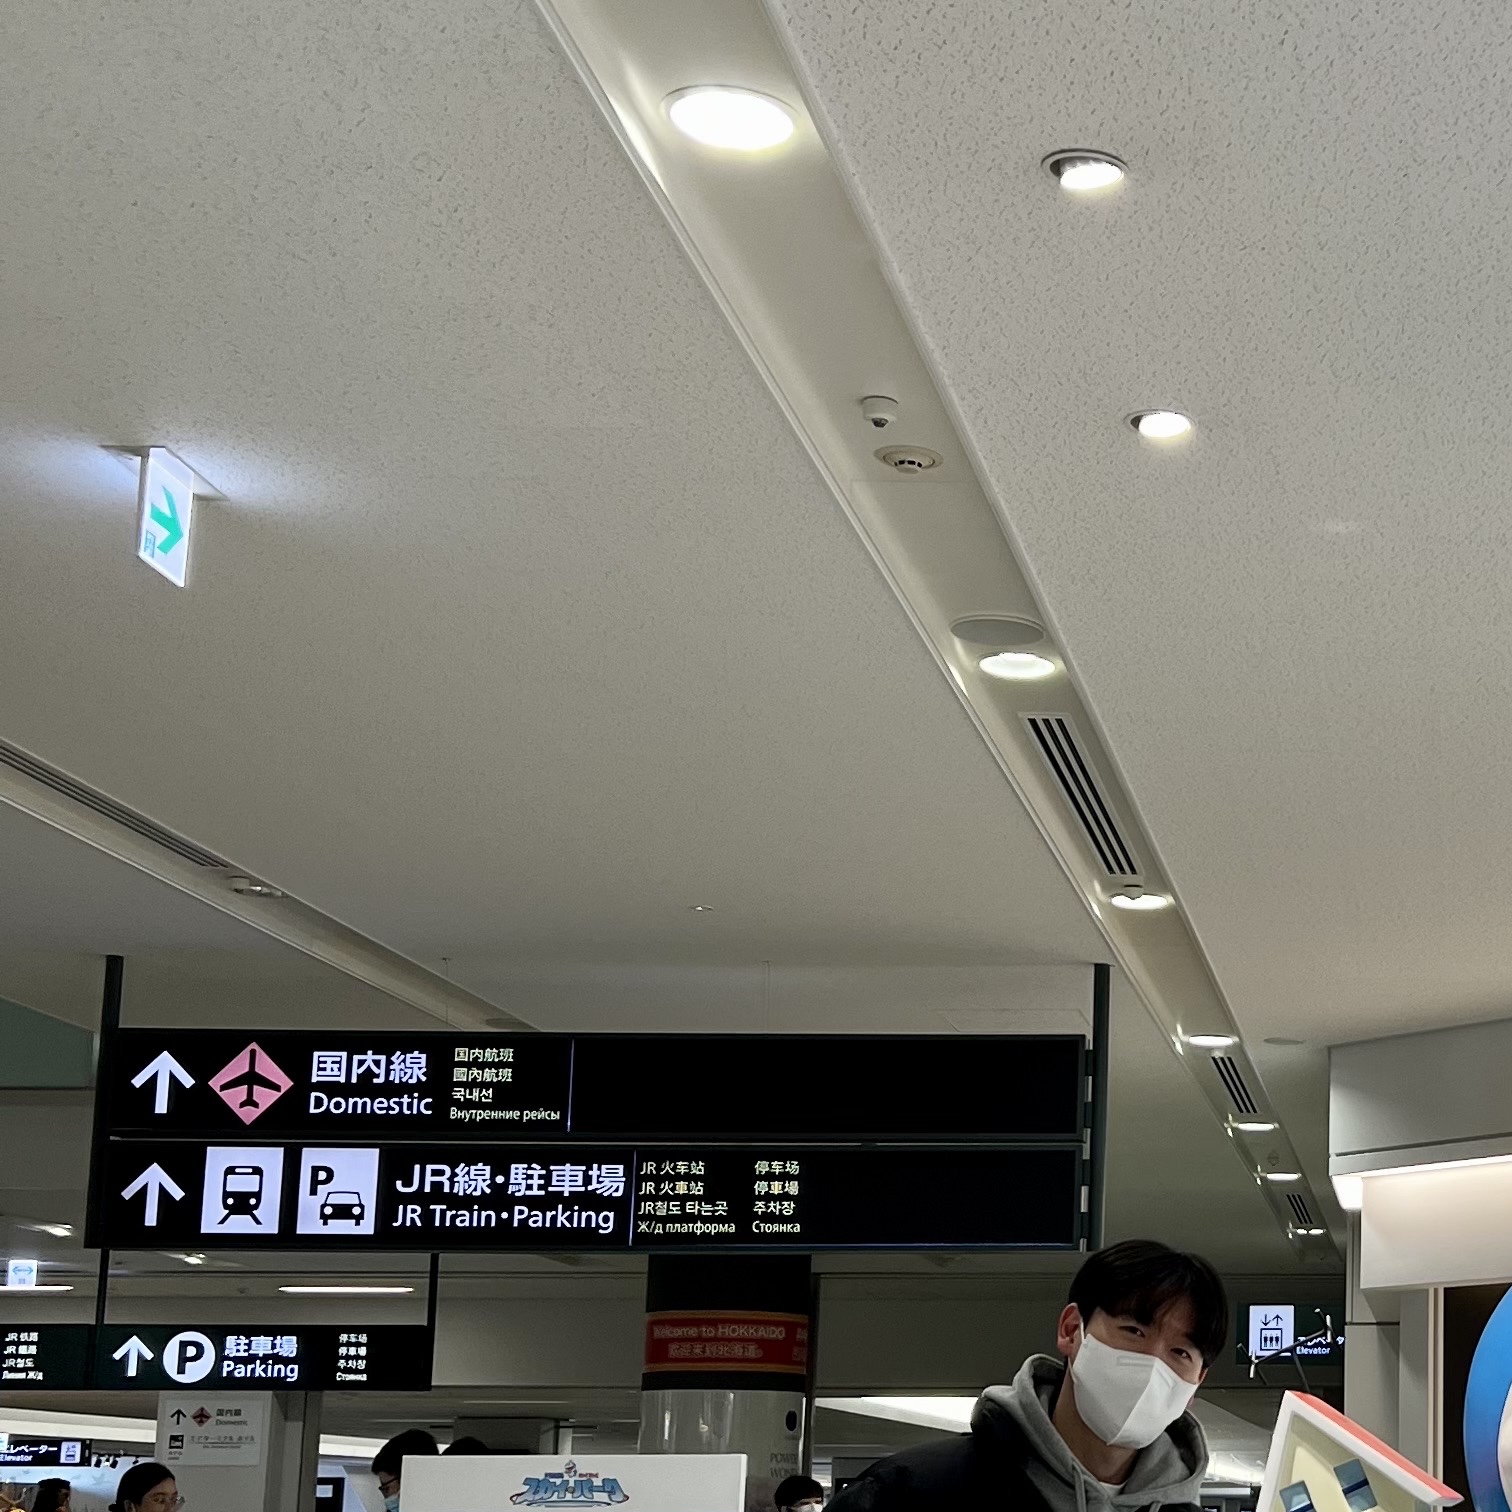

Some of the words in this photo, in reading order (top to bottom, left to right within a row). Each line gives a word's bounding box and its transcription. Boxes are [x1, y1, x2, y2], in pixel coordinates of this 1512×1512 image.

[454, 1047, 514, 1063] 国内航班
[310, 1051, 428, 1084] 国内線
[452, 1087, 493, 1103] 국내선
[309, 1092, 433, 1115] Domestic
[450, 1107, 520, 1122] Внутренние
[523, 1107, 560, 1122] рейсы
[640, 1163, 657, 1175] JR
[660, 1161, 706, 1175] 火车站
[755, 1161, 800, 1175] 停车场
[395, 1162, 626, 1198] JR線・駐車場
[638, 1182, 656, 1195] JR
[660, 1181, 705, 1195] 火車站
[754, 1181, 799, 1195] 停車場
[638, 1201, 682, 1216] JR철도
[686, 1201, 728, 1216] 타는곳
[753, 1201, 796, 1216] 주차장
[392, 1207, 423, 1228] JR
[637, 1221, 664, 1234] Ж/д
[666, 1221, 736, 1235] платформа
[752, 1221, 801, 1233] Стоянка
[653, 1325, 698, 1339] Welcome
[702, 1326, 716, 1338] to
[718, 1324, 786, 1340] HOKKAIDO
[223, 1335, 299, 1358] 駐車場
[1296, 1346, 1331, 1355] Elevator
[222, 1358, 300, 1381] Parking
[337, 1359, 367, 1370] 주차장
